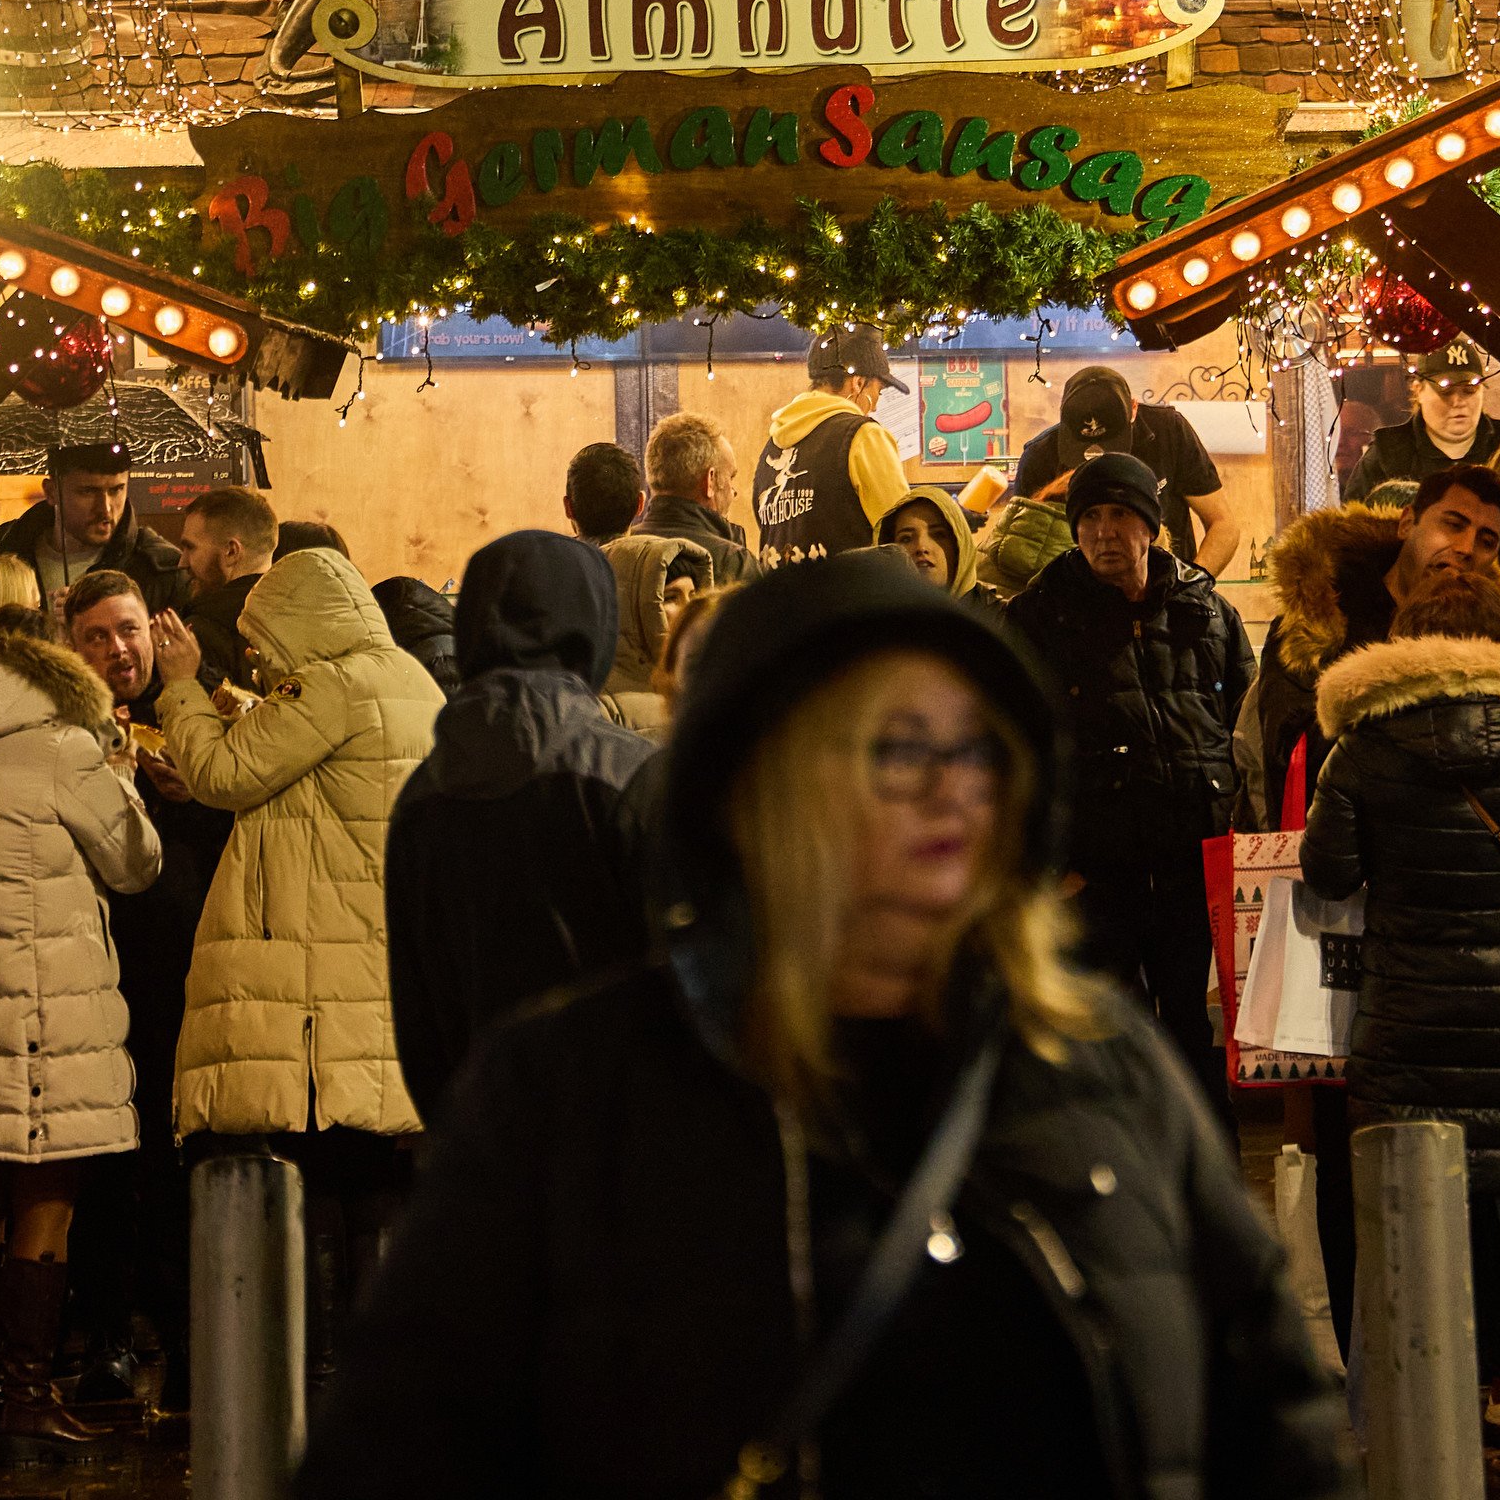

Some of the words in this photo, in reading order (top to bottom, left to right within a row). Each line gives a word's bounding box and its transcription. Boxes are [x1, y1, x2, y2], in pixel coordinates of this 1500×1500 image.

[208, 162, 390, 277] Big
[406, 105, 799, 236] German
[819, 84, 1213, 236] Sausag
[178, 375, 211, 389] Offe
[797, 489, 814, 498] 1999
[779, 498, 813, 523] HOUSE
